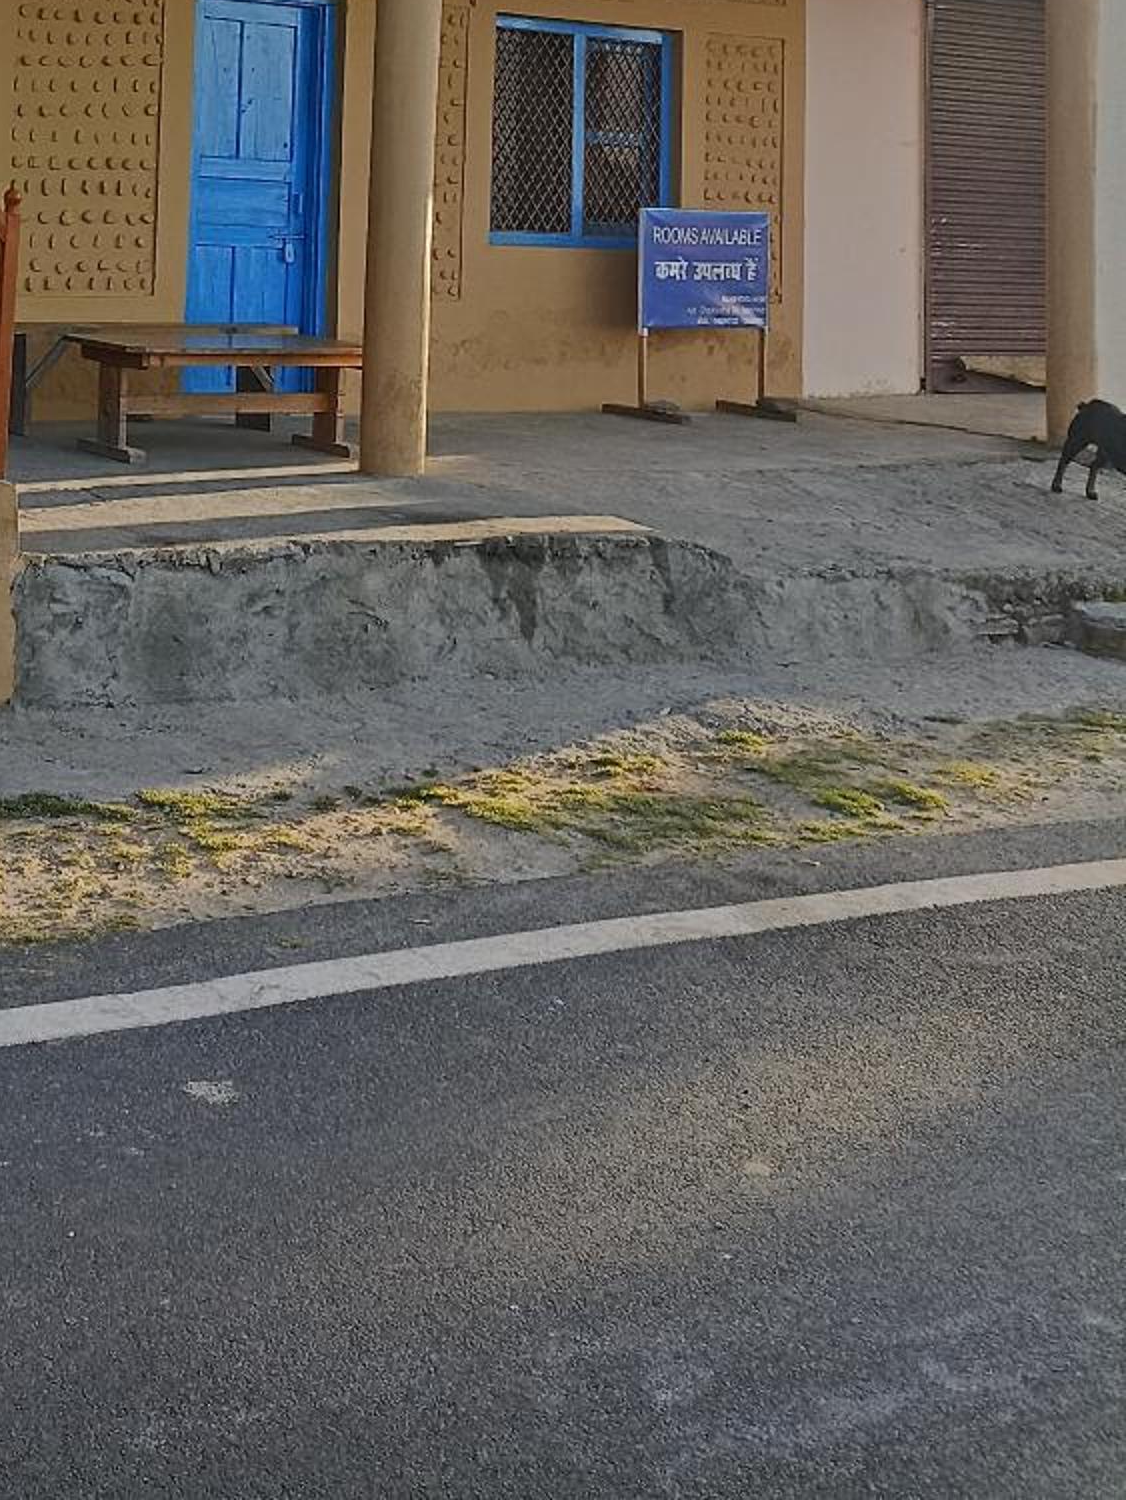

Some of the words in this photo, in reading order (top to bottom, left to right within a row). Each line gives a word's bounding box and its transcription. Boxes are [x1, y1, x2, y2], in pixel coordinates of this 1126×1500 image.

[653, 225, 699, 246] ROOMS
[700, 228, 762, 246] AVAILABLE
[654, 255, 689, 281] कमरे
